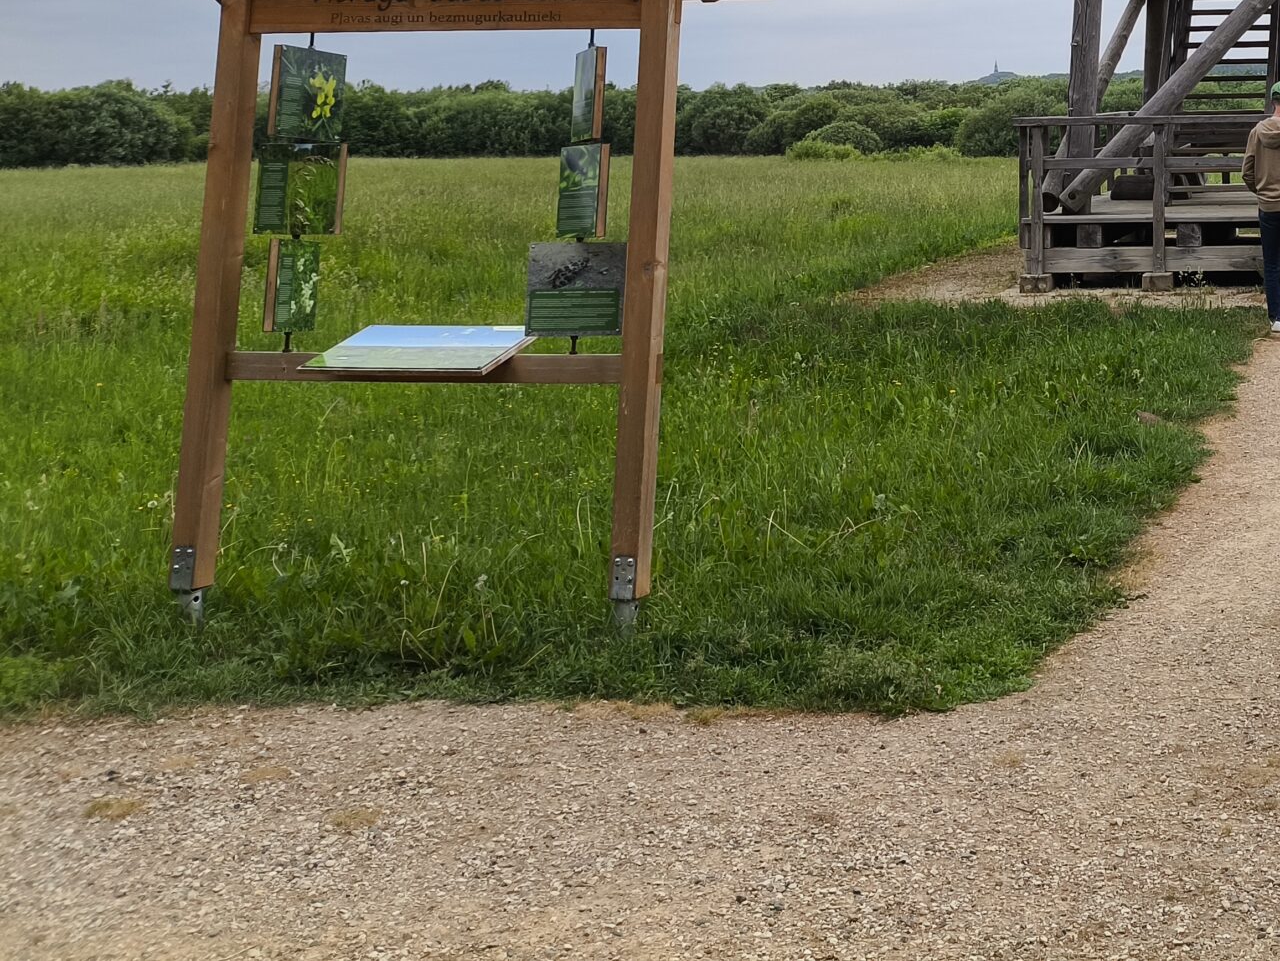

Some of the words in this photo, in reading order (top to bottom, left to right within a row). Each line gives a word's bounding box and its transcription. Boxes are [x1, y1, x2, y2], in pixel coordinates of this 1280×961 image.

[374, 12, 403, 26] augi
[407, 14, 424, 23] un
[429, 11, 561, 26] bezmugurkaulnieki
